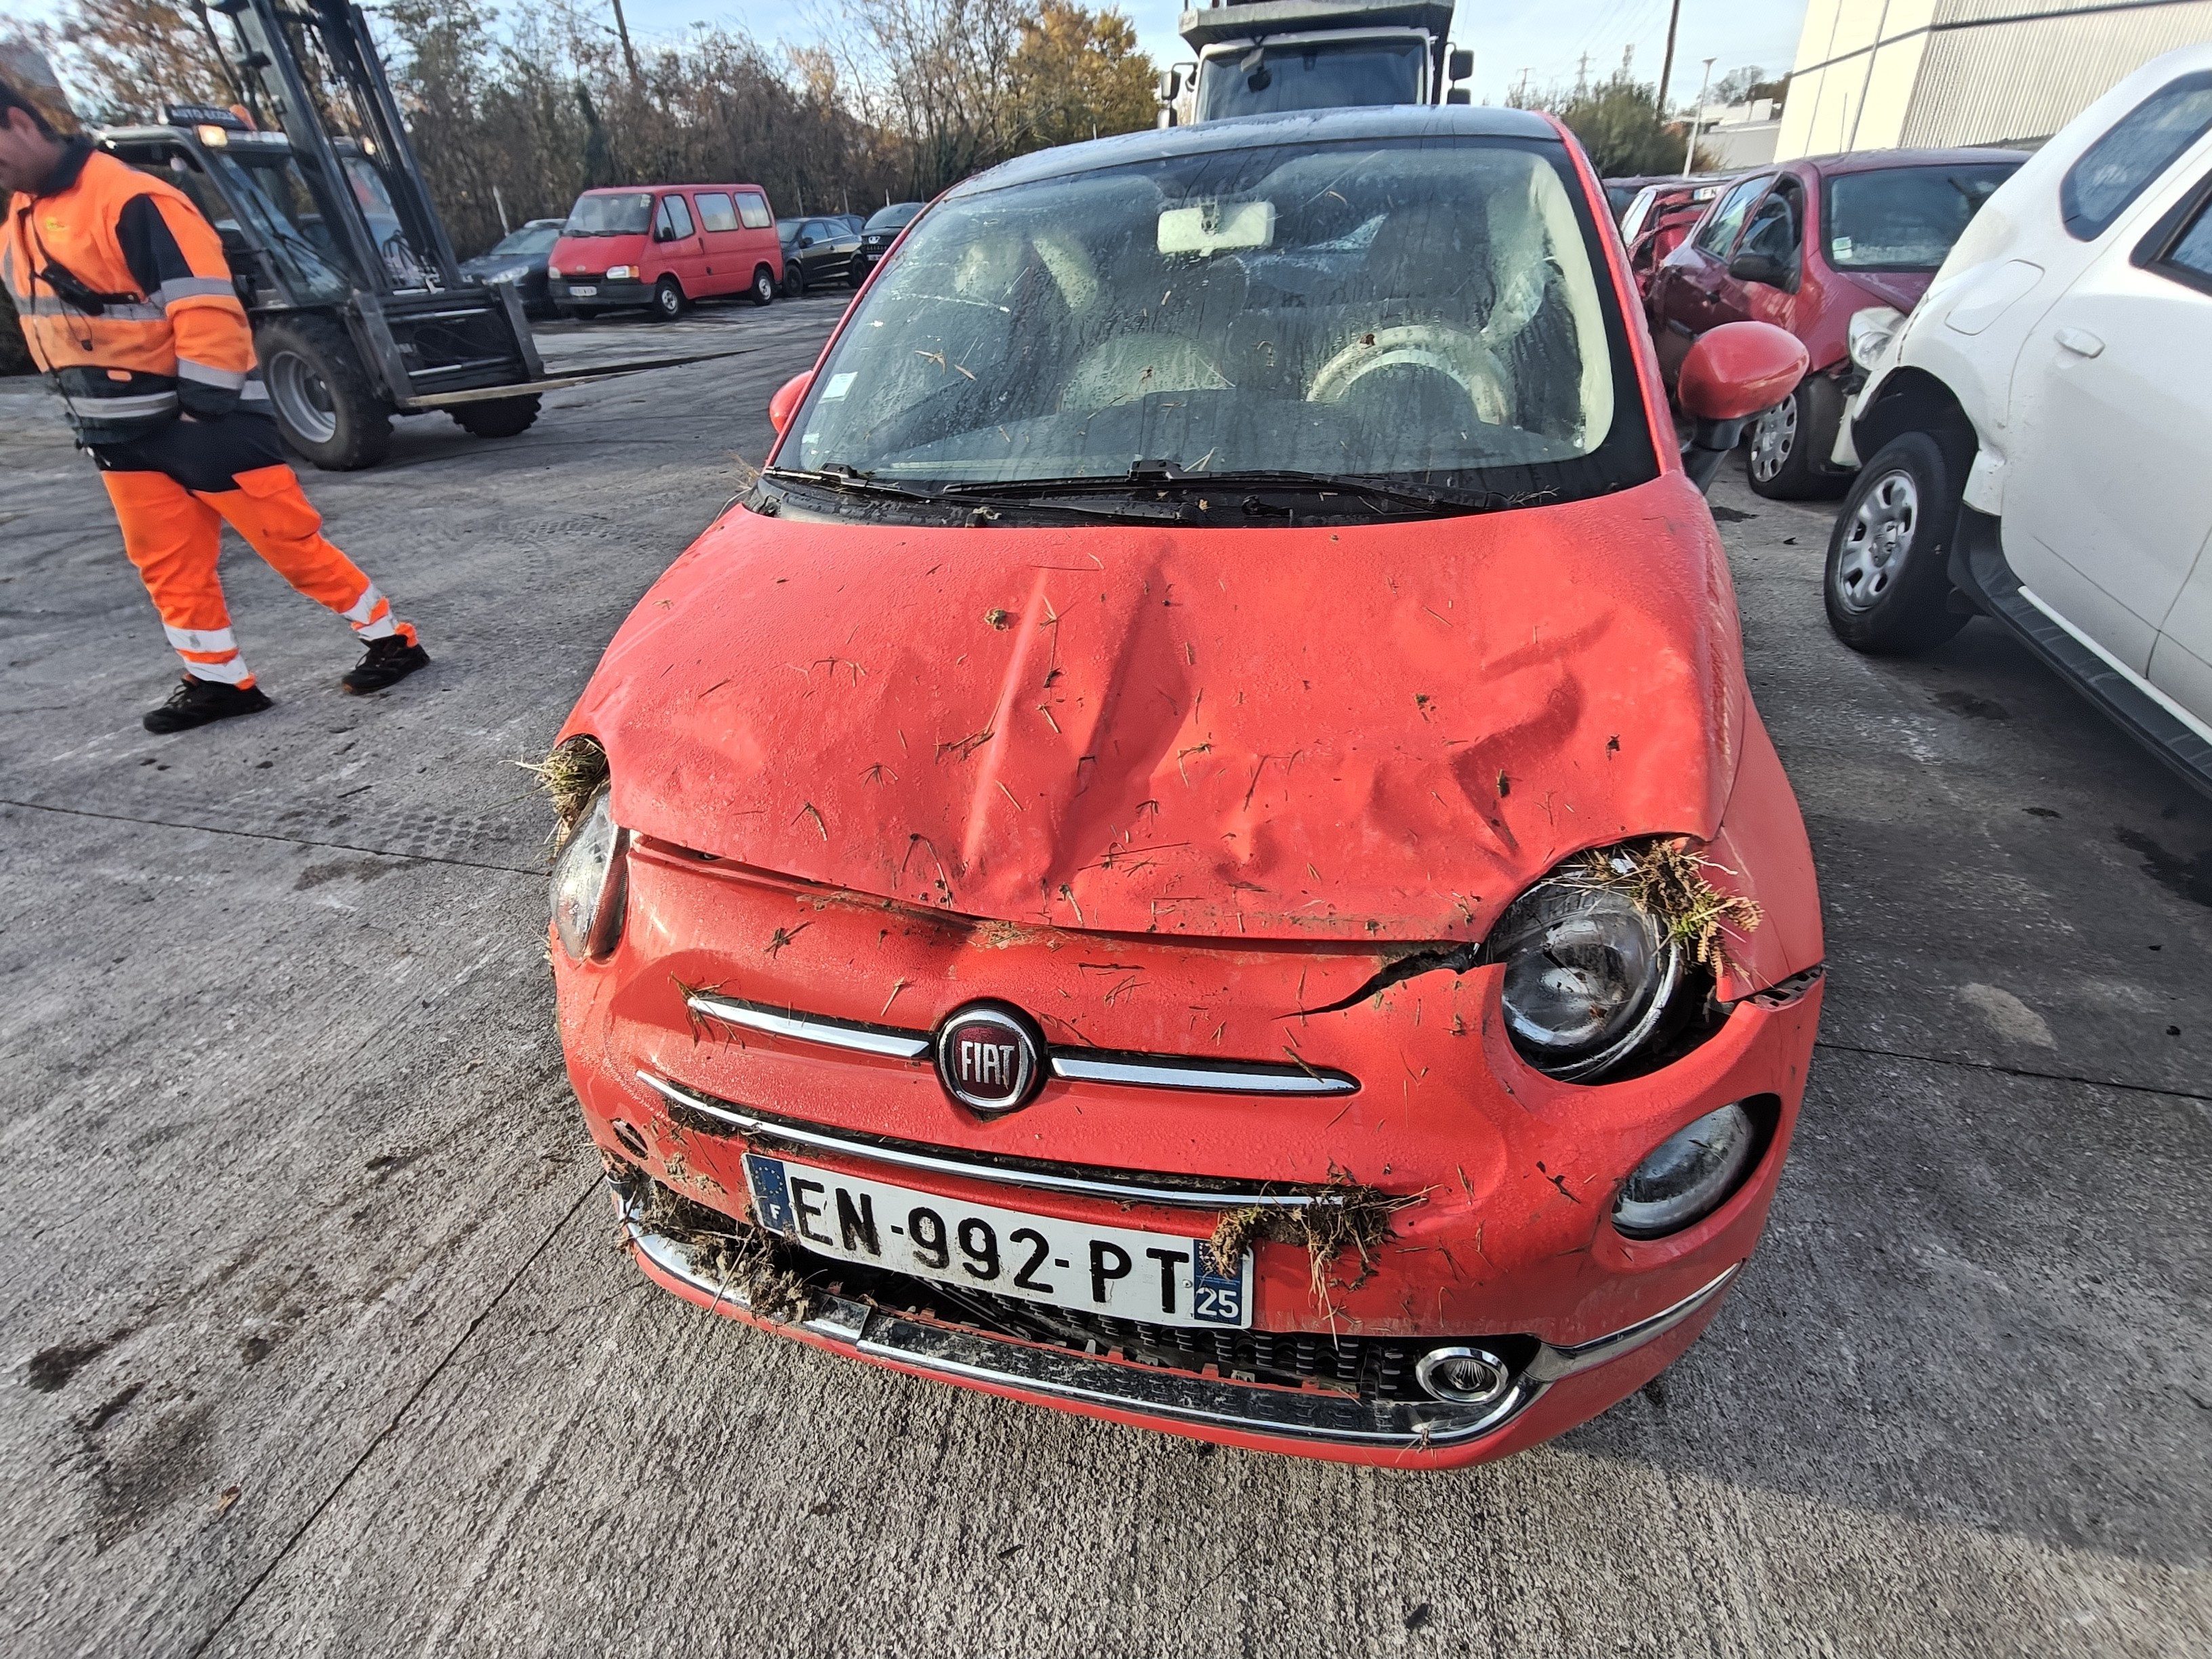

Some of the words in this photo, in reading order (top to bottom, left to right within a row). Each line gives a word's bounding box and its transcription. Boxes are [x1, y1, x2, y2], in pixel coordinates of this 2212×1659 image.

[961, 1040, 1015, 1085] FIAT
[769, 1203, 781, 1219] F
[1196, 1287, 1239, 1318] 25
